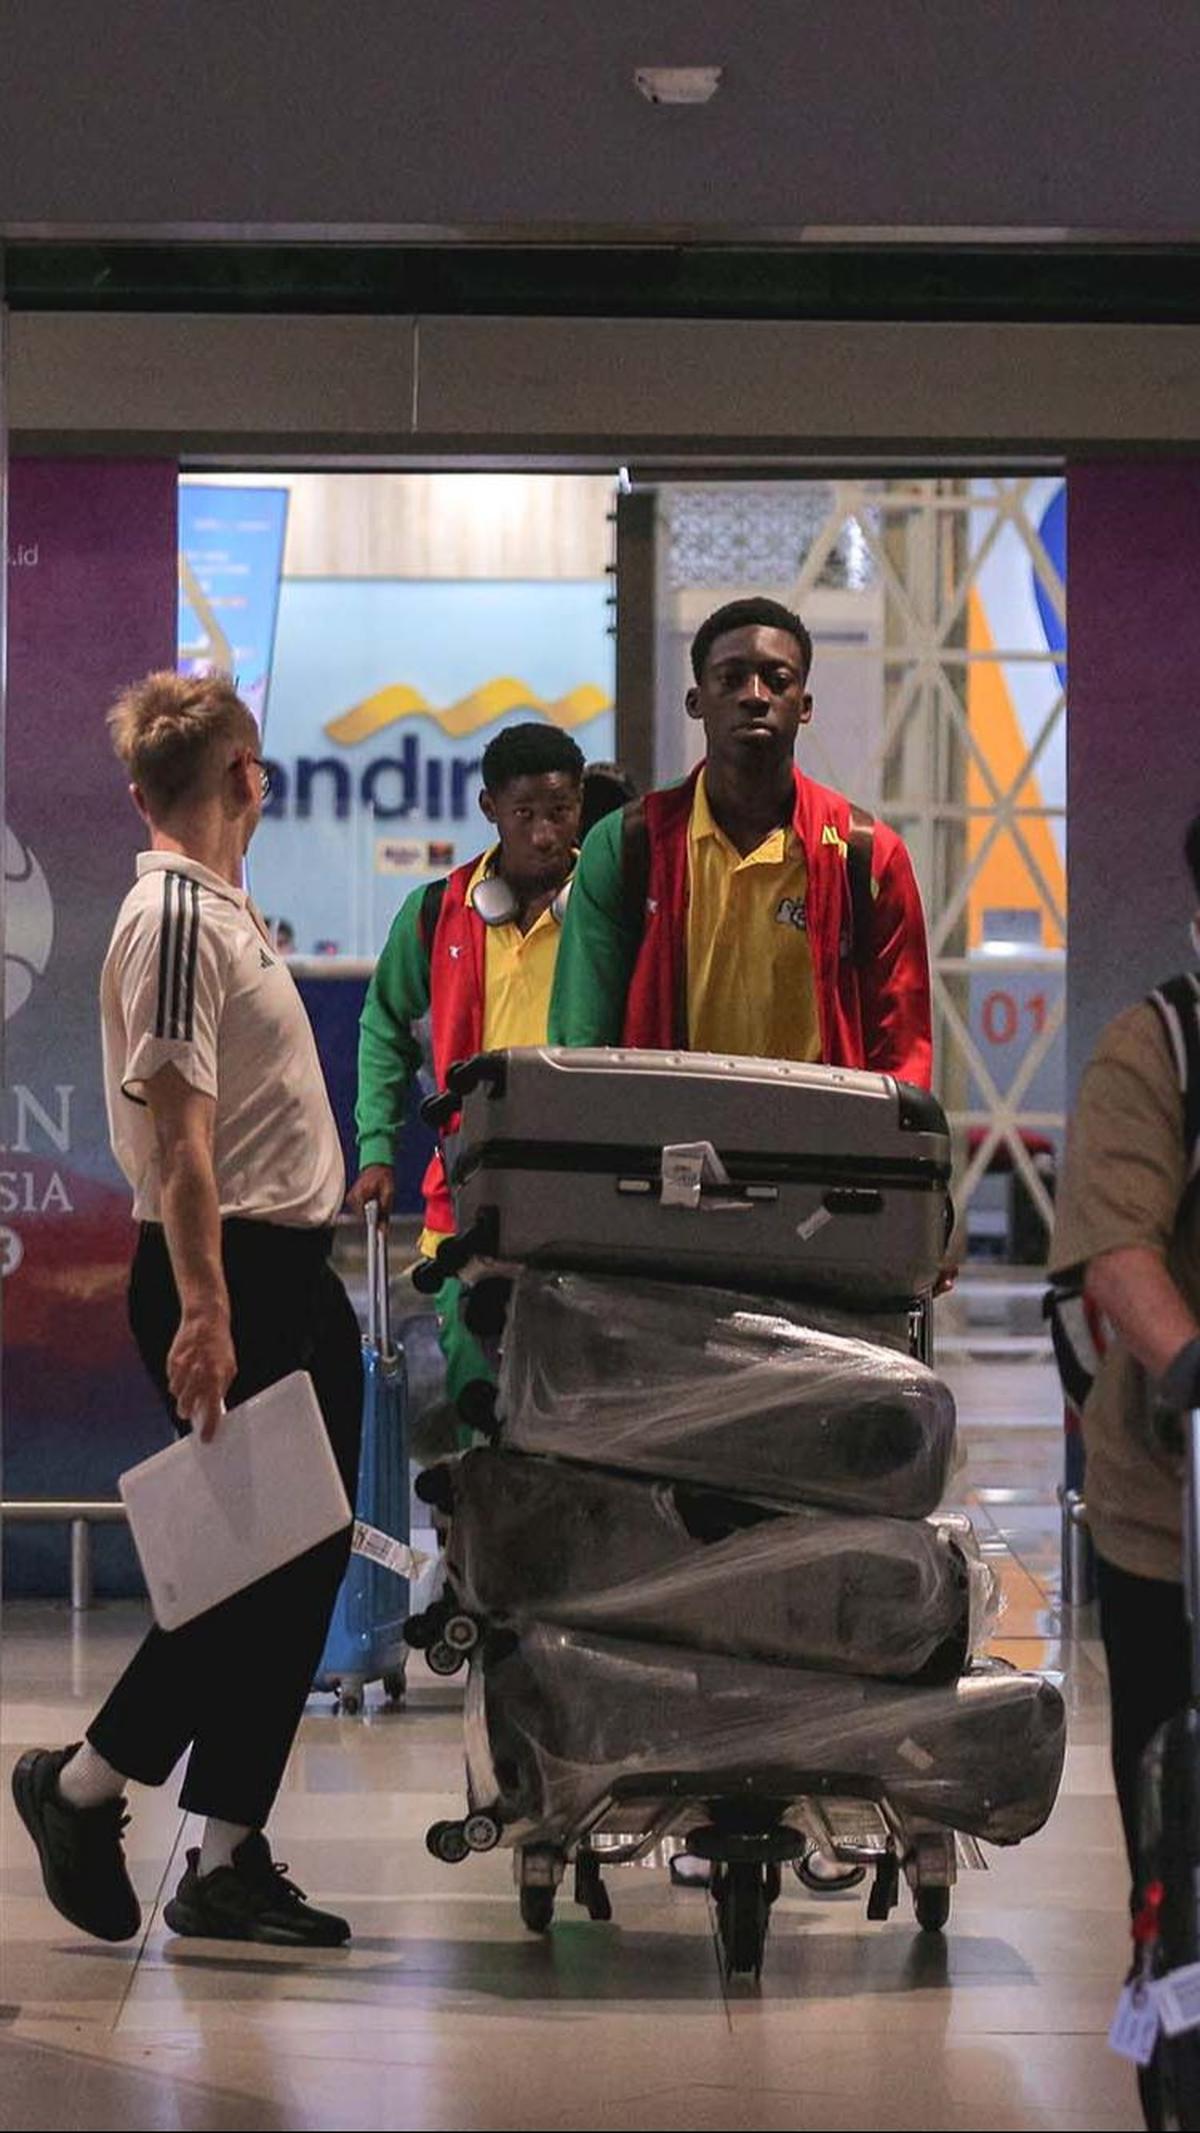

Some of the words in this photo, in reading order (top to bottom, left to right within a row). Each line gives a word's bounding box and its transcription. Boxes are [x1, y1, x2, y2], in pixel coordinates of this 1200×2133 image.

[8, 543, 39, 566] .id
[981, 991, 1046, 1046] 01
[0, 1084, 75, 1153] N
